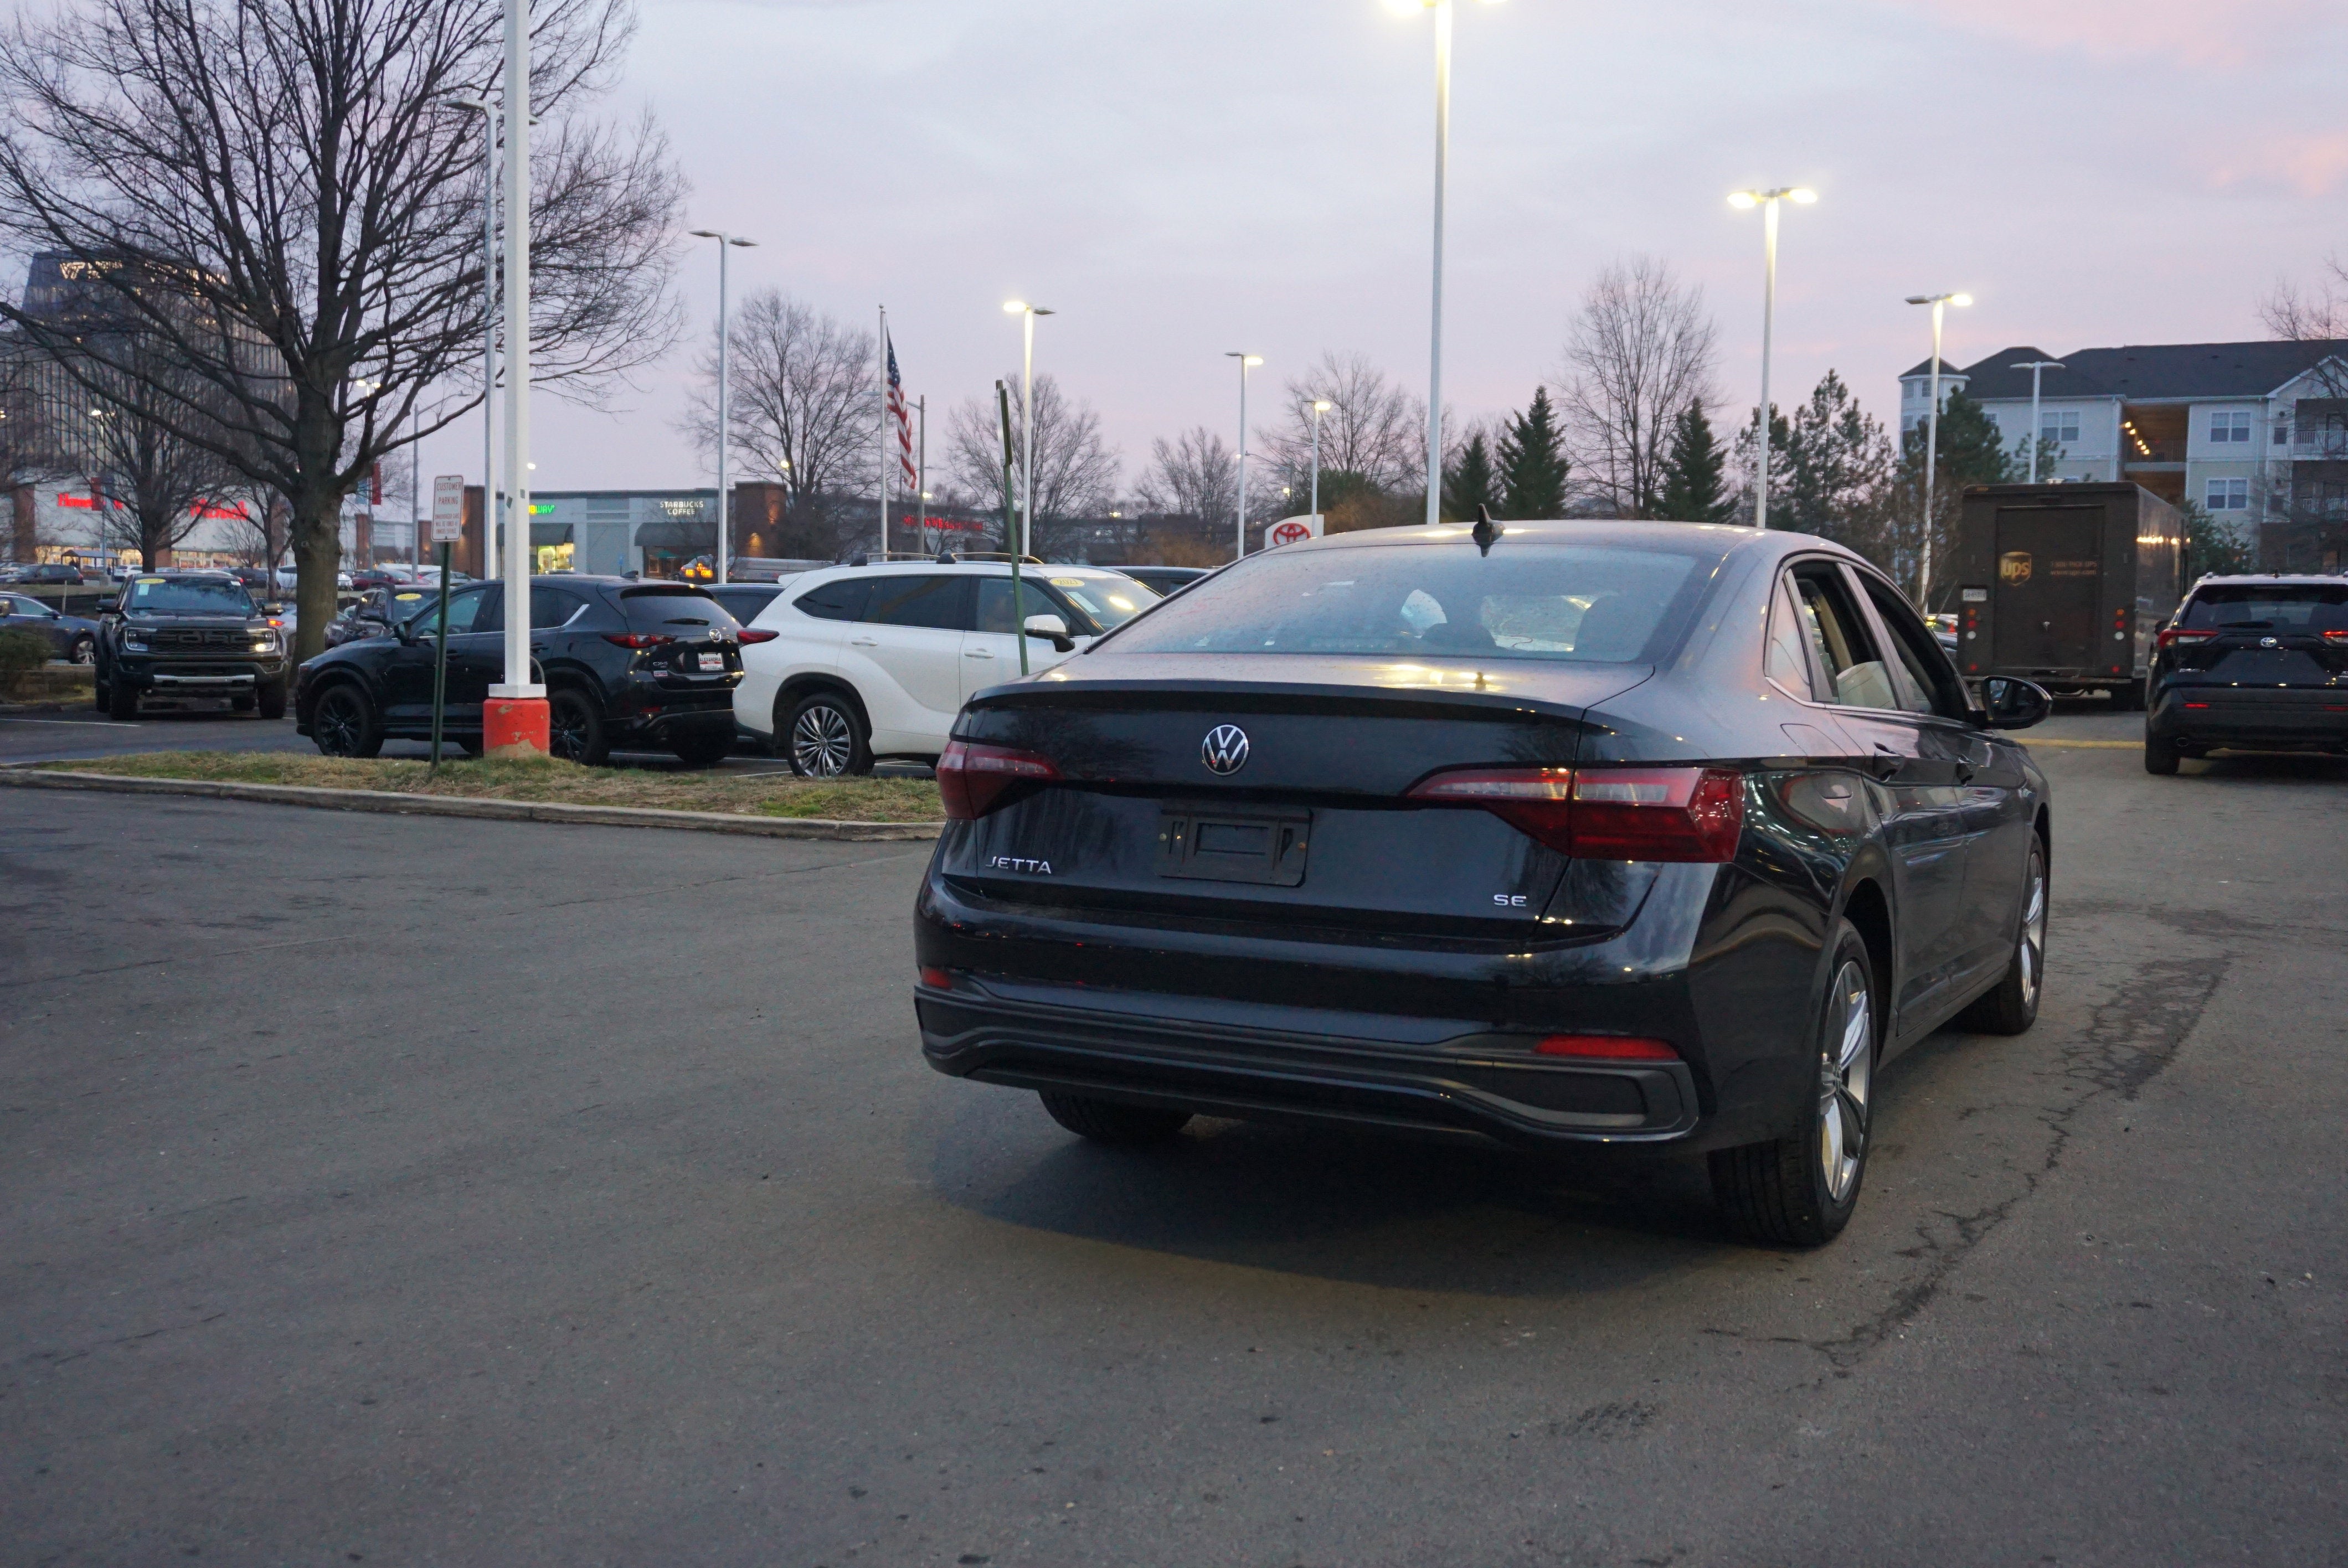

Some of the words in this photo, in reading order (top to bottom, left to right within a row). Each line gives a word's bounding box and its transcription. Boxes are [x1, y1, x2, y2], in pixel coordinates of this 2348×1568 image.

[436, 482, 462, 491] CUSTOMER
[438, 496, 459, 505] PARKING
[529, 504, 555, 513] BWAY
[986, 856, 1052, 874] JETTA
[1494, 894, 1527, 907] SE
